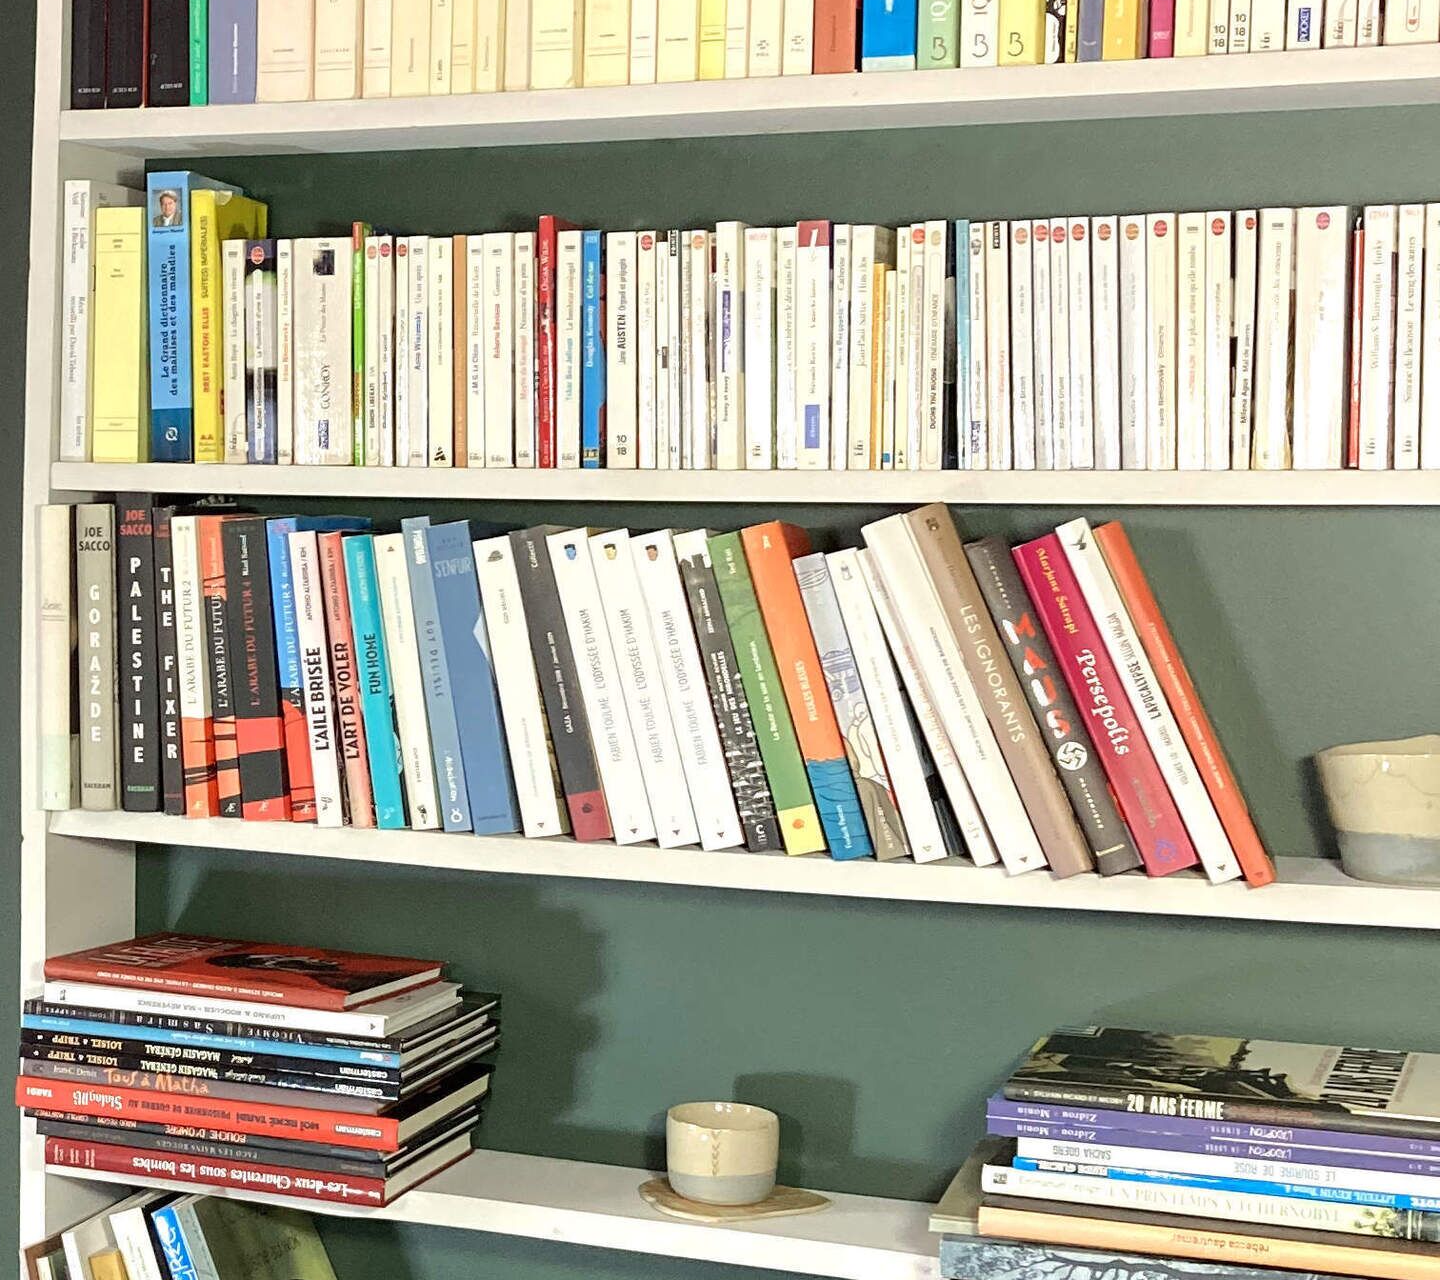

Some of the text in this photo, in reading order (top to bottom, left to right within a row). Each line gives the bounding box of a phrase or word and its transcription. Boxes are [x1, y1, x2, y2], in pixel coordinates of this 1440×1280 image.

[1214, 25, 1225, 34] 10
[1214, 37, 1225, 47] 18
[159, 262, 169, 377] Le Grand dictionnaire
[167, 243, 178, 395] des malaises et des maladies
[617, 313, 626, 349] AUSTEN
[125, 509, 145, 521] JOE
[84, 526, 103, 538] JOE
[119, 523, 152, 536] SACCO
[78, 540, 111, 552] SACCO
[1035, 547, 1078, 635] Marjane Satrapi
[182, 588, 195, 631] FUTUR
[184, 633, 195, 652] DU
[213, 635, 225, 653] DU
[243, 588, 262, 706] L'ARABE DU FUTUR
[87, 584, 103, 743] GORAŽDE
[129, 556, 145, 764] PALESTINE
[160, 567, 178, 760] THE FIXER
[364, 632, 383, 694] FUN HOME
[184, 654, 198, 705] L'ARABE
[215, 656, 229, 707] L'ARABE
[958, 603, 1027, 745] LES IGNORANTS
[1001, 612, 1072, 739] MAUS
[304, 645, 330, 751] L'AILE BRISÉE
[334, 640, 361, 759] L'ART DE VOLER
[1075, 647, 1132, 757] Persepolis
[50, 1033, 122, 1050] LOISEL TRIPP
[245, 1025, 303, 1042] VICOMTE
[46, 1049, 118, 1066] LOISEL TRIPP
[143, 1042, 220, 1061] MAGASIN GÉNÉRAL
[139, 1058, 216, 1076] MAGASIN GÉNÉRAL
[338, 1065, 388, 1079] casterman
[103, 1067, 211, 1094] Tous à Matha
[334, 1082, 382, 1096] casterman
[24, 1085, 52, 1098] TARDI
[1016, 1106, 1096, 1123] Zidrou Monin
[1127, 1093, 1225, 1120] 20 ANS FERME
[163, 1123, 246, 1142] BOUCHE D'OMBRE
[333, 1123, 381, 1138] casterman
[1015, 1122, 1095, 1140] Zidrou Monin
[131, 1156, 347, 1198] Les deux Charentes sous les bombes
[1232, 1160, 1336, 1181] LE SOURIRE DE ROSE
